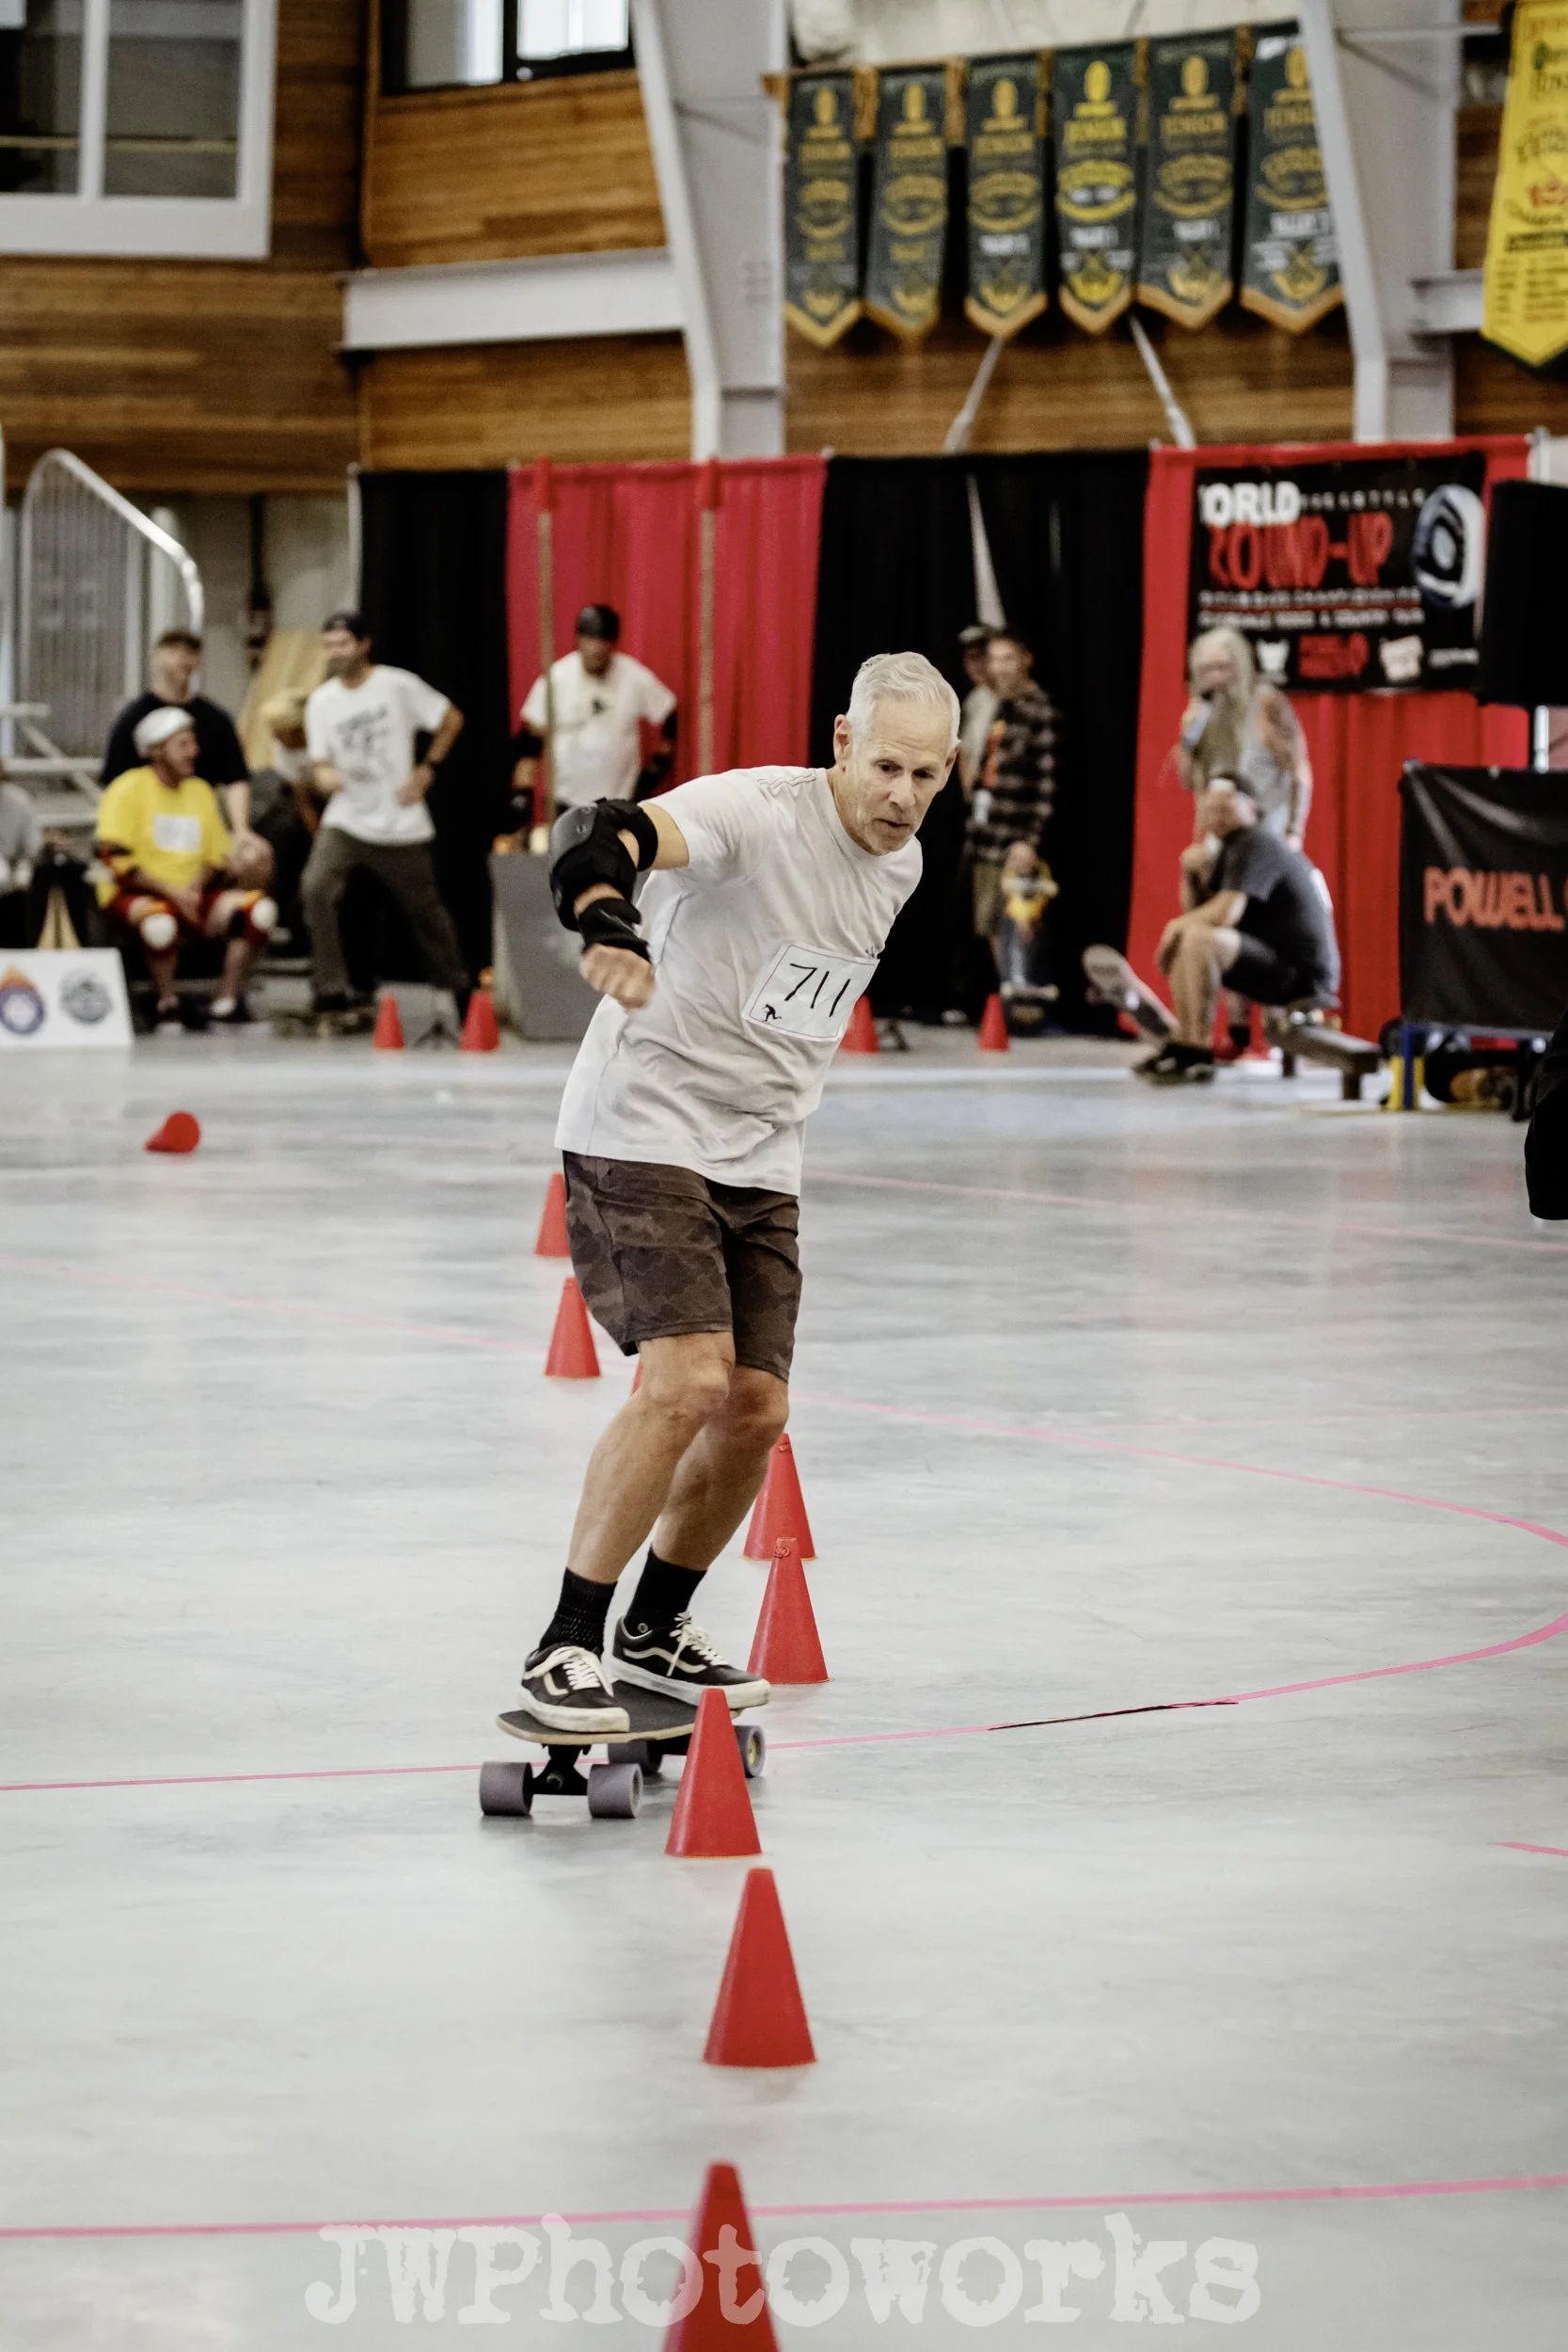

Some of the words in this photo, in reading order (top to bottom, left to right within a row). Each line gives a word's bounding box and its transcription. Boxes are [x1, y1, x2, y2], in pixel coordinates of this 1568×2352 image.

[1197, 481, 1302, 527] ORLD
[1423, 866, 1565, 931] POWELL
[784, 962, 850, 1018] 711
